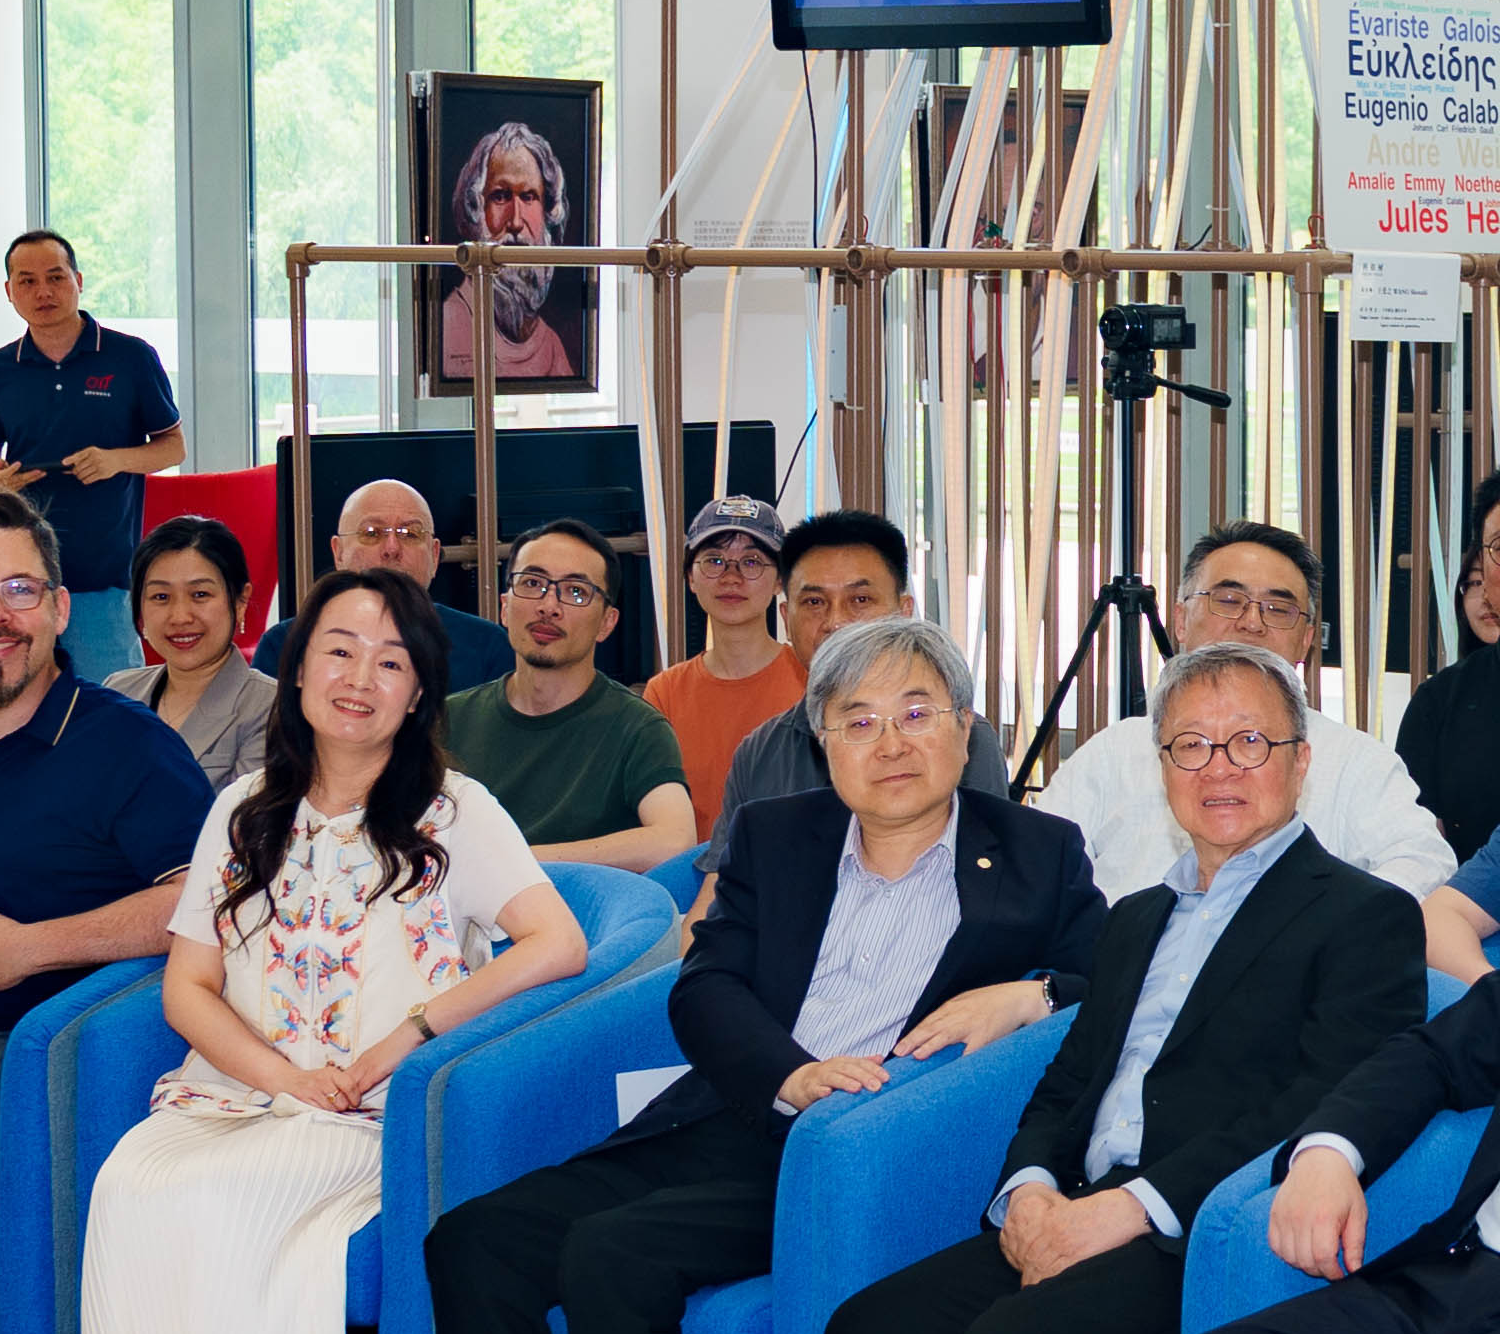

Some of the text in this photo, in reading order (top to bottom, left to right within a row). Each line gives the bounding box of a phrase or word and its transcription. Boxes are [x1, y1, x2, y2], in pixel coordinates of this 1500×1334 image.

[1349, 1, 1500, 44] Évariste Galois
[1345, 92, 1429, 127] Eugenio
[1367, 133, 1440, 167] André
[1348, 171, 1396, 191] Amalie
[1404, 173, 1446, 196] Emmy
[1378, 199, 1449, 233] Jules
